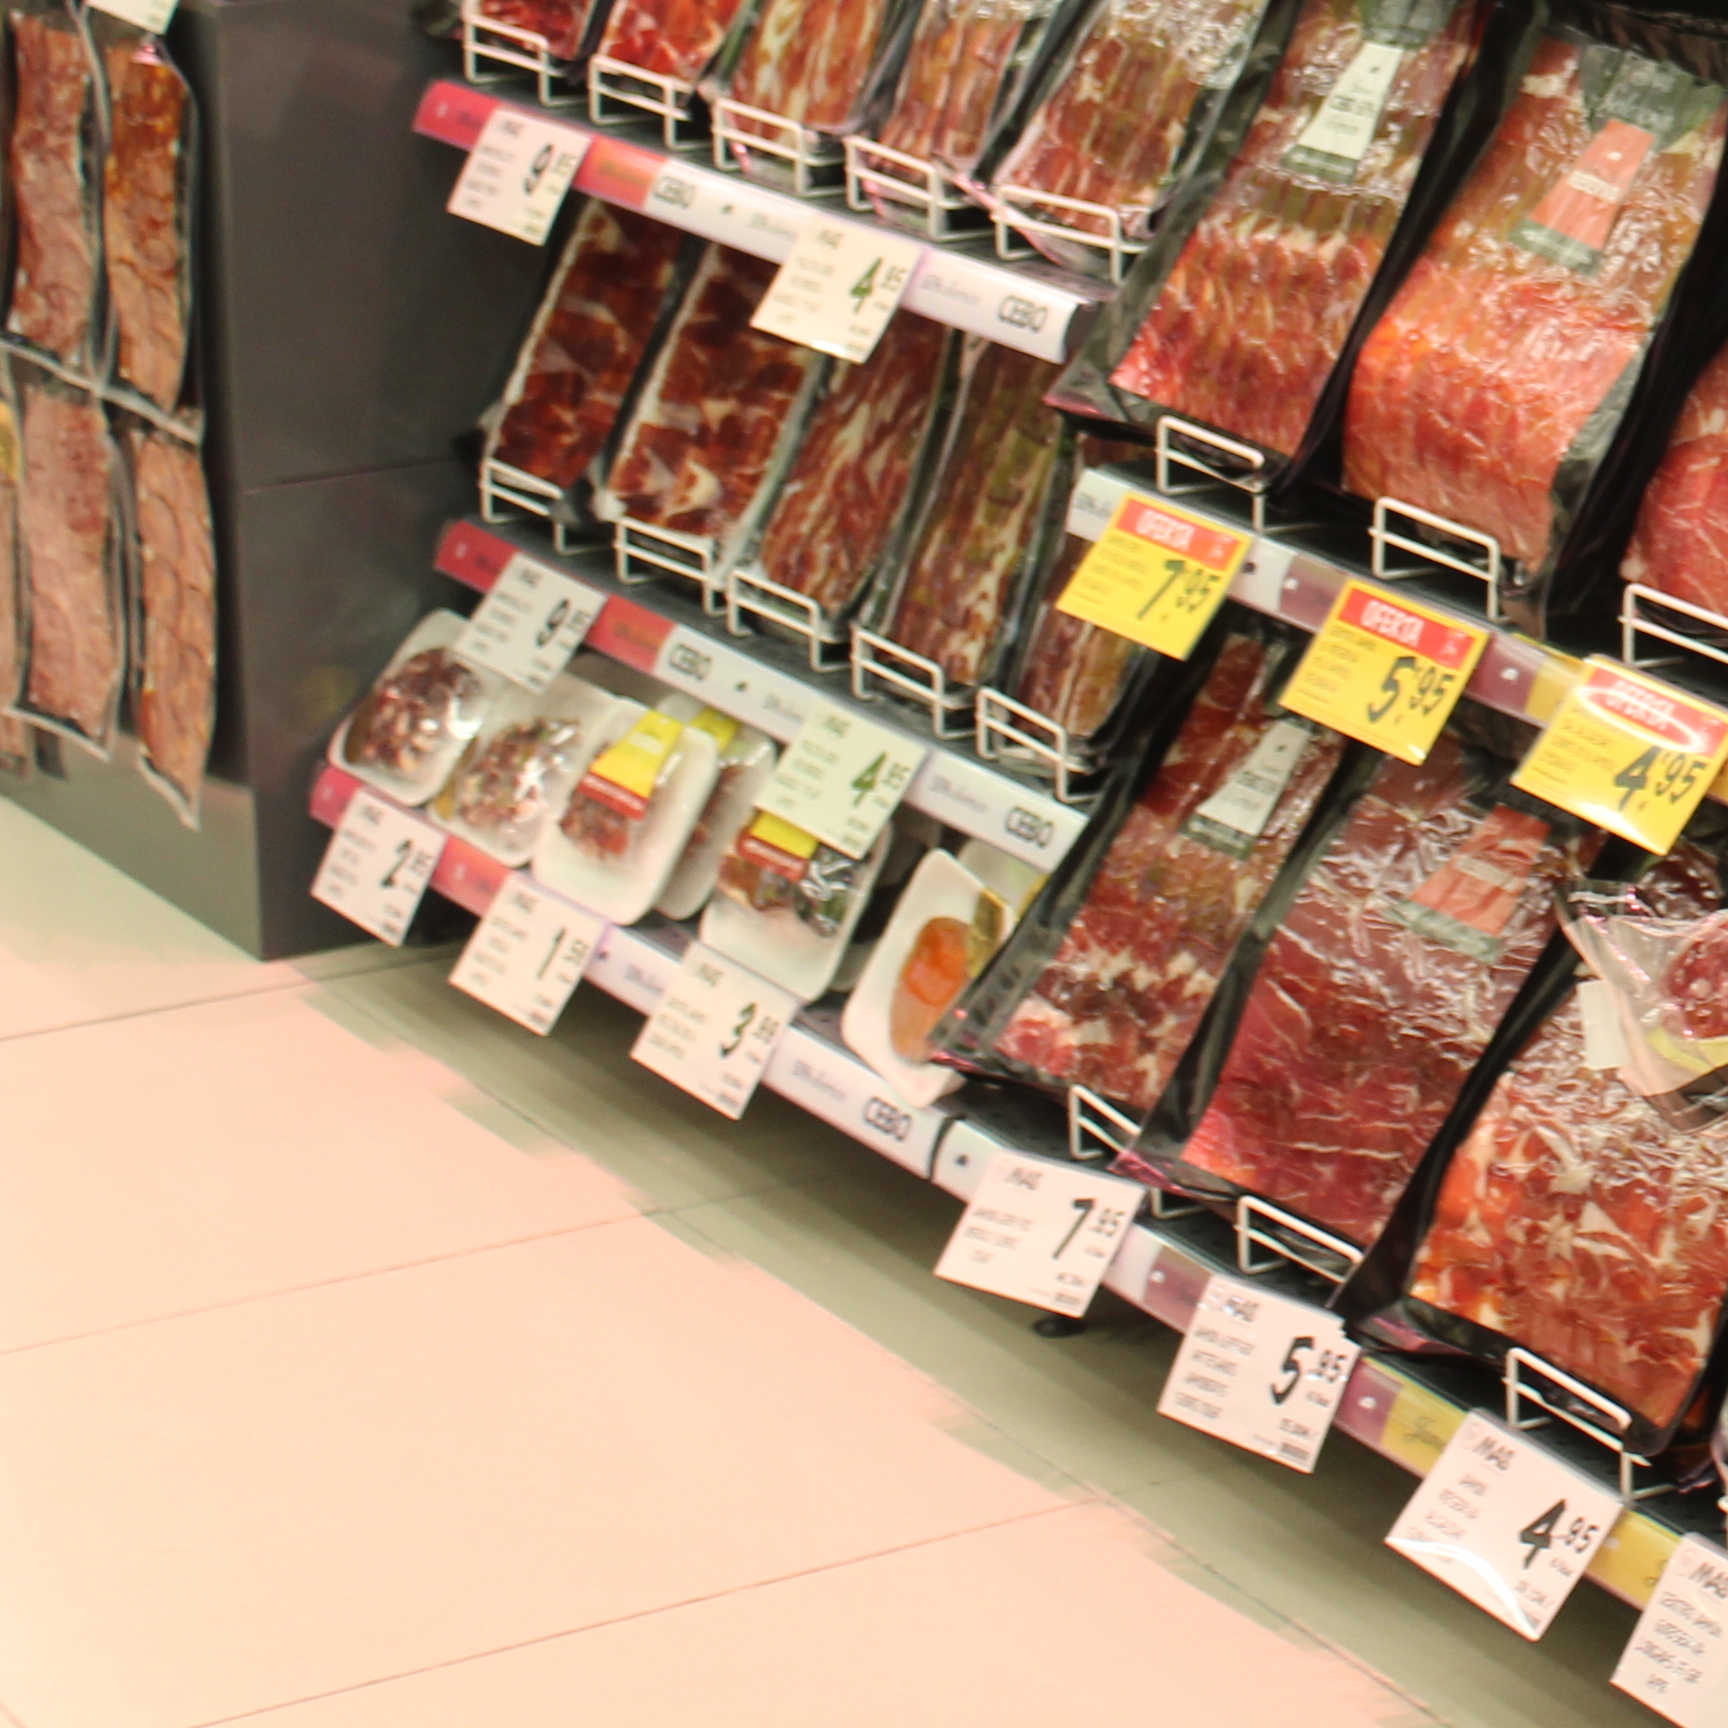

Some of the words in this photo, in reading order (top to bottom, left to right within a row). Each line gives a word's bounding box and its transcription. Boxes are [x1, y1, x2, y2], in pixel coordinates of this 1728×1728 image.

[1366, 654, 1456, 725] 5'95
[1613, 746, 1709, 813] 4'95
[1051, 1197, 1127, 1260] 7.95
[1268, 1335, 1348, 1406] 5.95
[1517, 1498, 1600, 1571] 4.95
